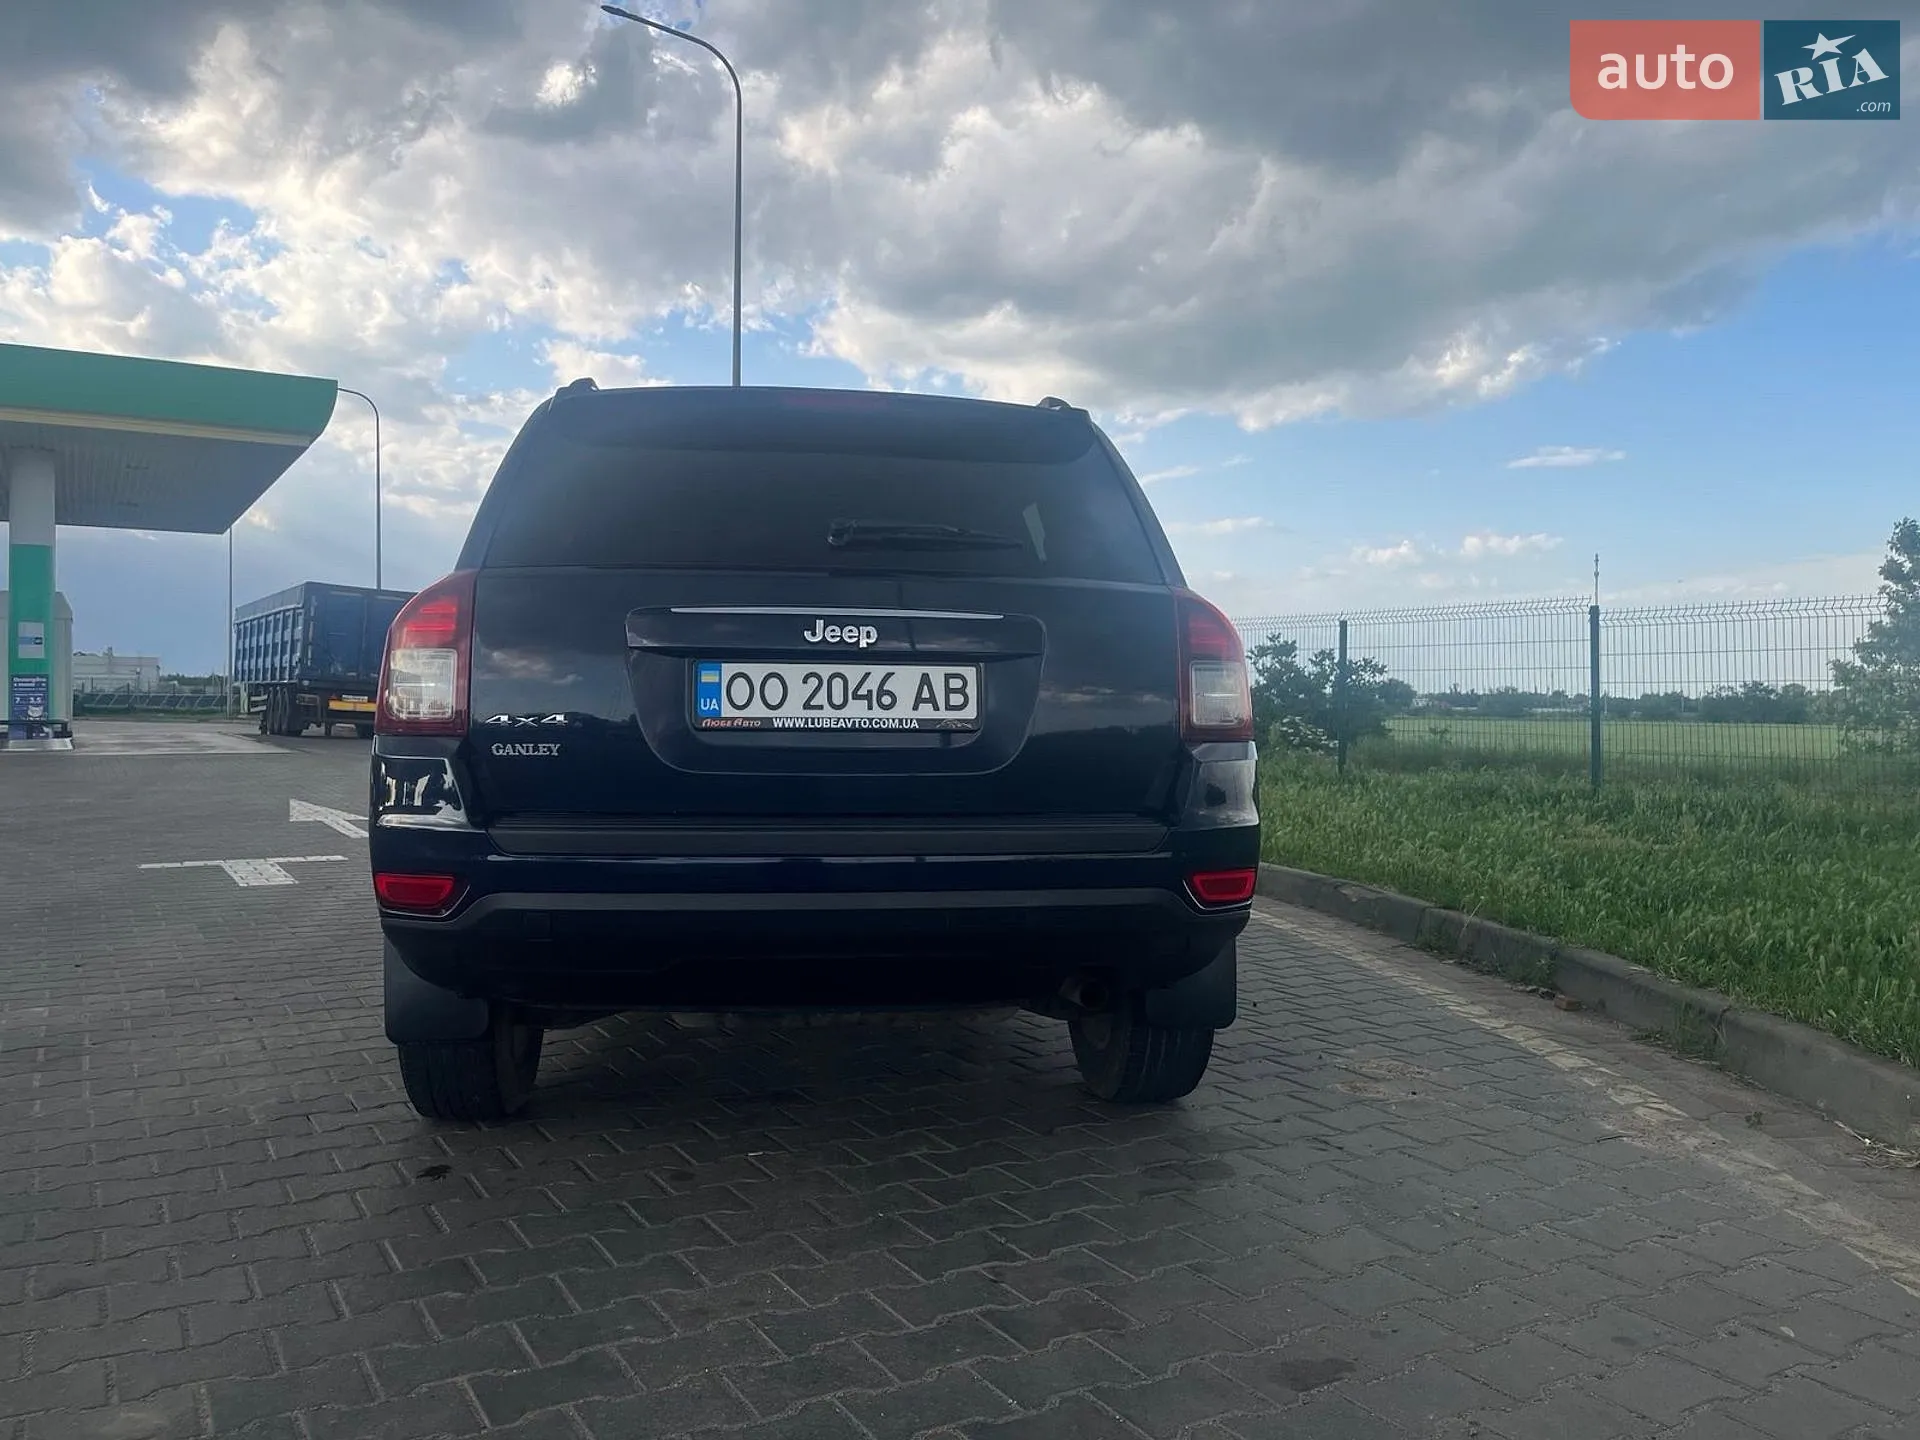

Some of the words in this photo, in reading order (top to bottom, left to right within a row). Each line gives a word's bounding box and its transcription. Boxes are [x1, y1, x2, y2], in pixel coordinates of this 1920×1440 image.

[803, 619, 878, 648] Jeep
[725, 671, 789, 711] OO
[801, 671, 898, 712] 2046
[912, 672, 970, 712] AB
[700, 699, 719, 711] UA
[772, 717, 919, 728] WWW.LUBEAVTO.COM.UA
[491, 742, 561, 756] GANLEY
